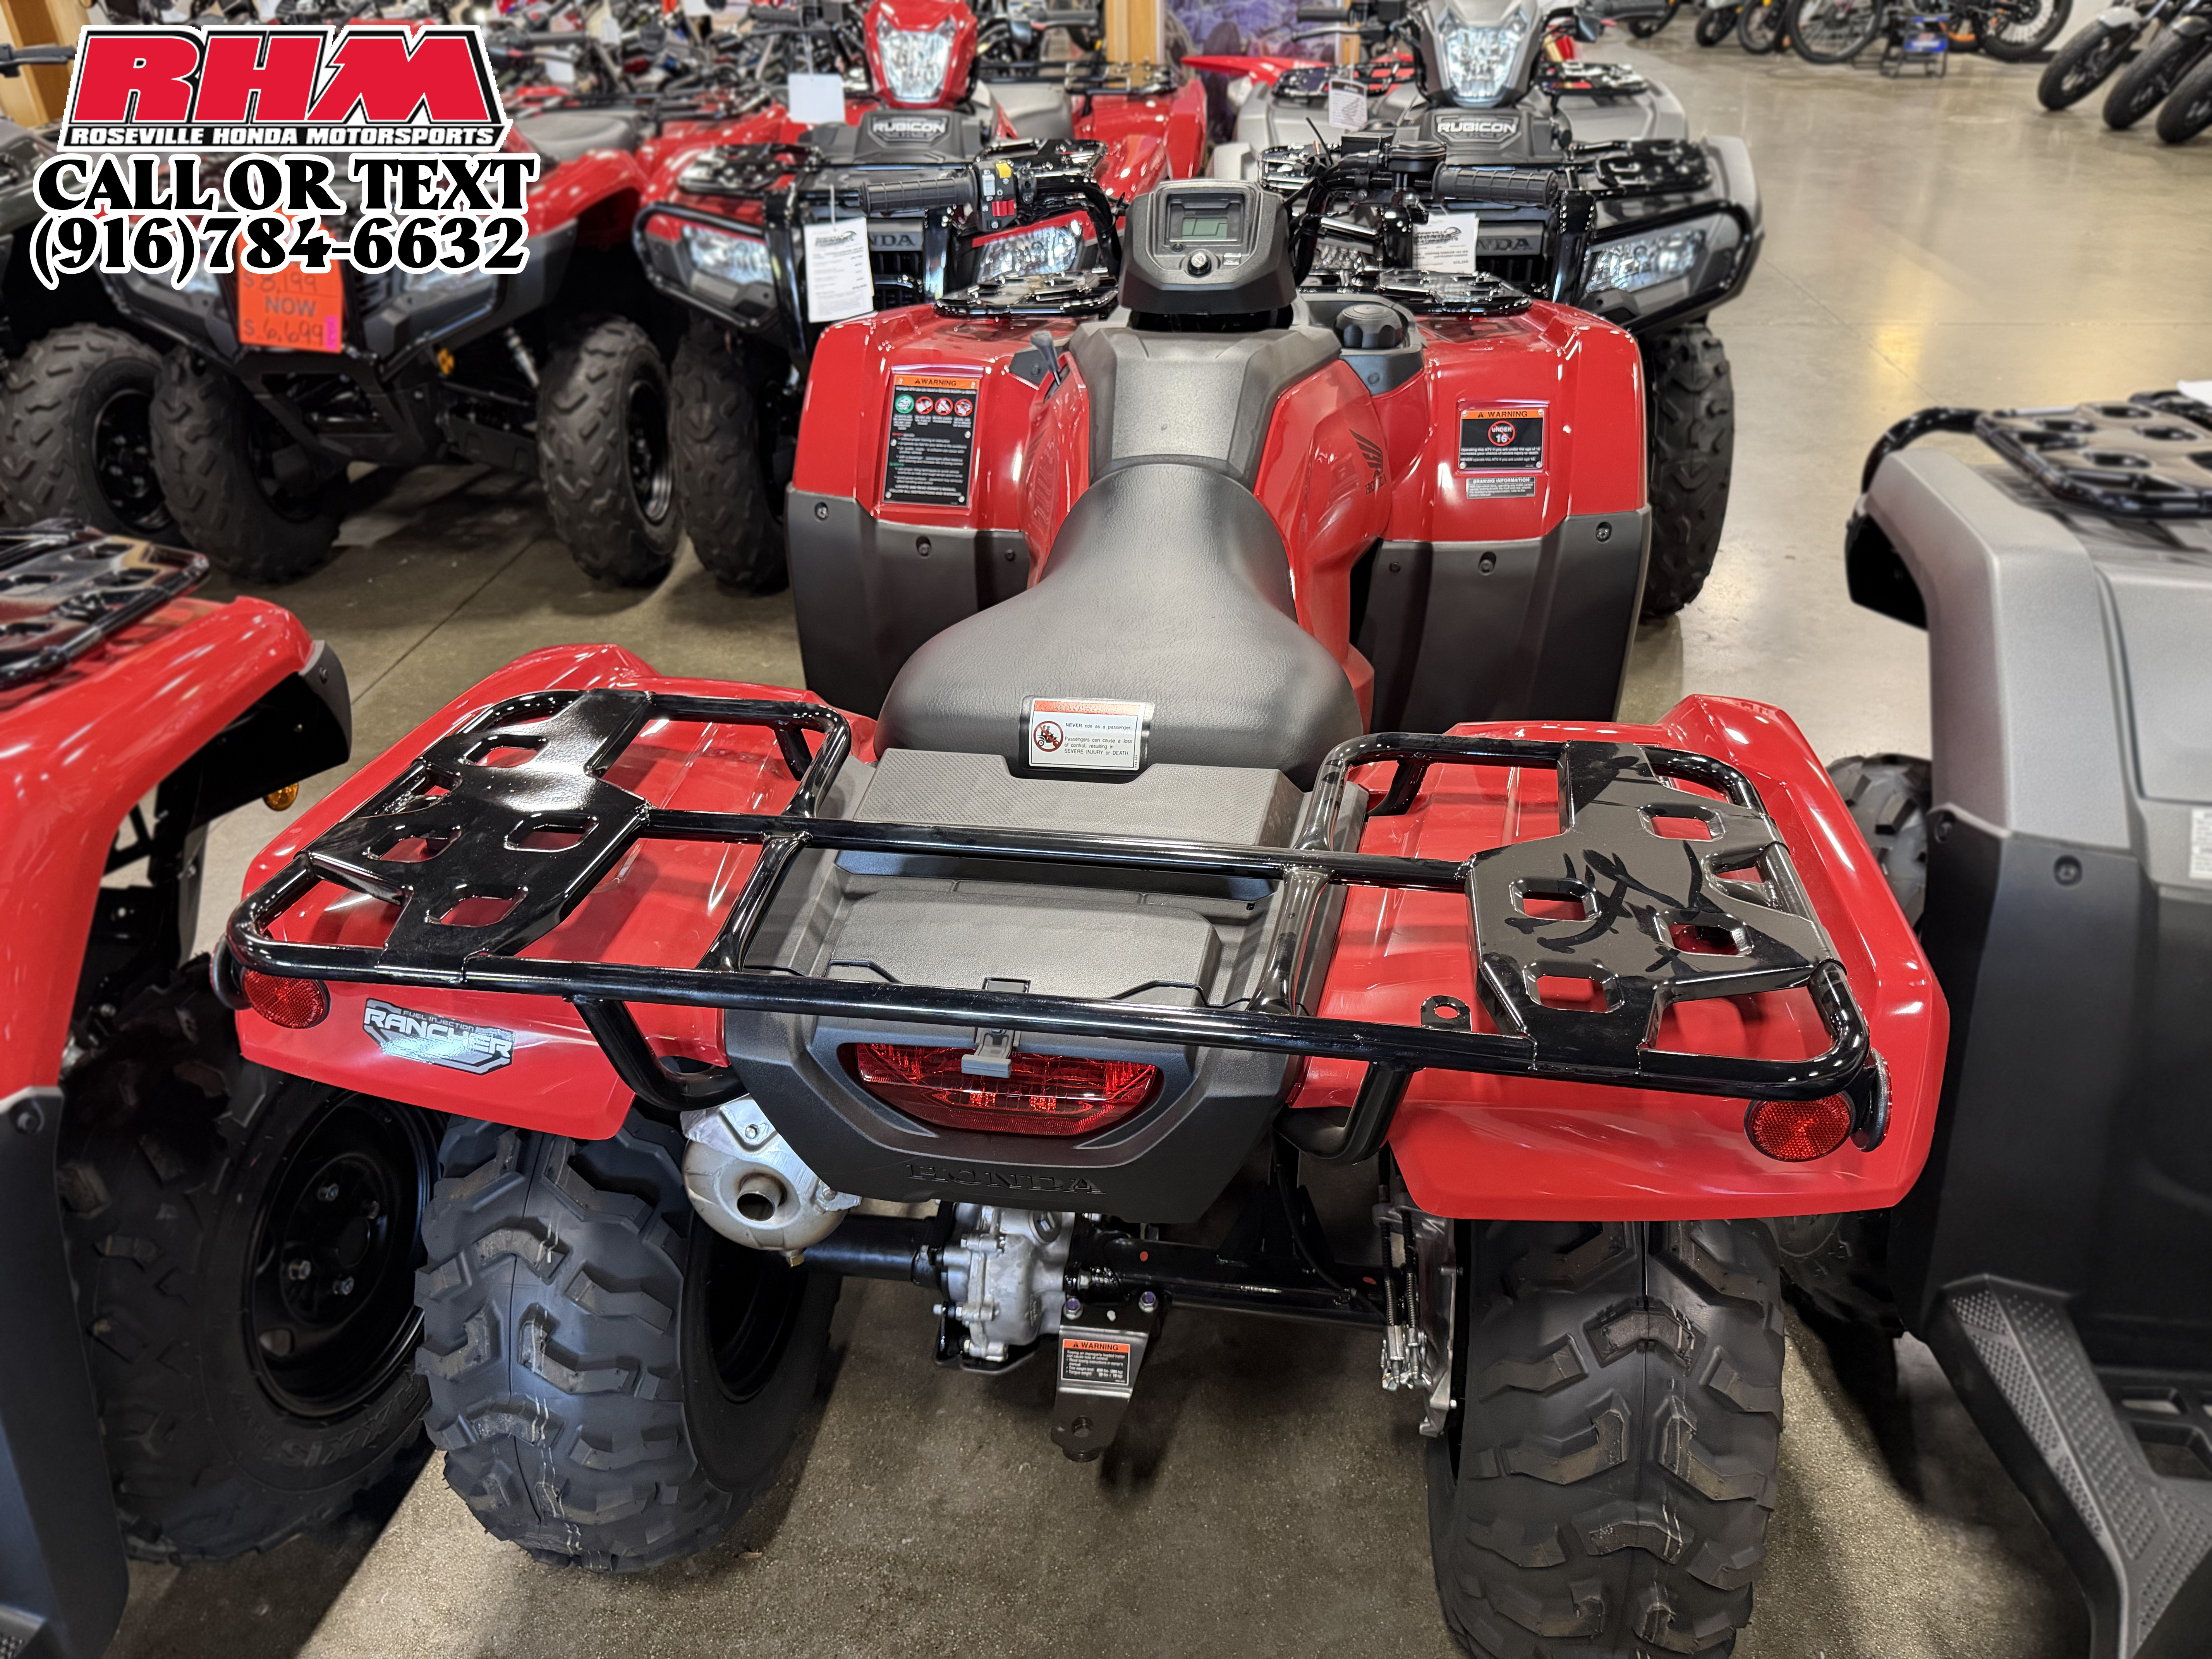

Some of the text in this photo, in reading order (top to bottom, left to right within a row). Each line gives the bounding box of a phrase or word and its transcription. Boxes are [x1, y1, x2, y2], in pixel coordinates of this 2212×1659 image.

[873, 122, 945, 134] RUBICON
[1437, 122, 1516, 134] RUBICON
[868, 235, 915, 246] NDA
[1476, 238, 1533, 251] NDA
[264, 295, 317, 318] NOW
[1496, 433, 1508, 443] 16
[403, 1010, 474, 1032] FUEL INJECTION
[364, 1007, 512, 1058] RANCHER
[905, 1164, 1107, 1195] HONDA
[1081, 1341, 1118, 1351] WARNING
[279, 1370, 420, 1467] AXXIS
